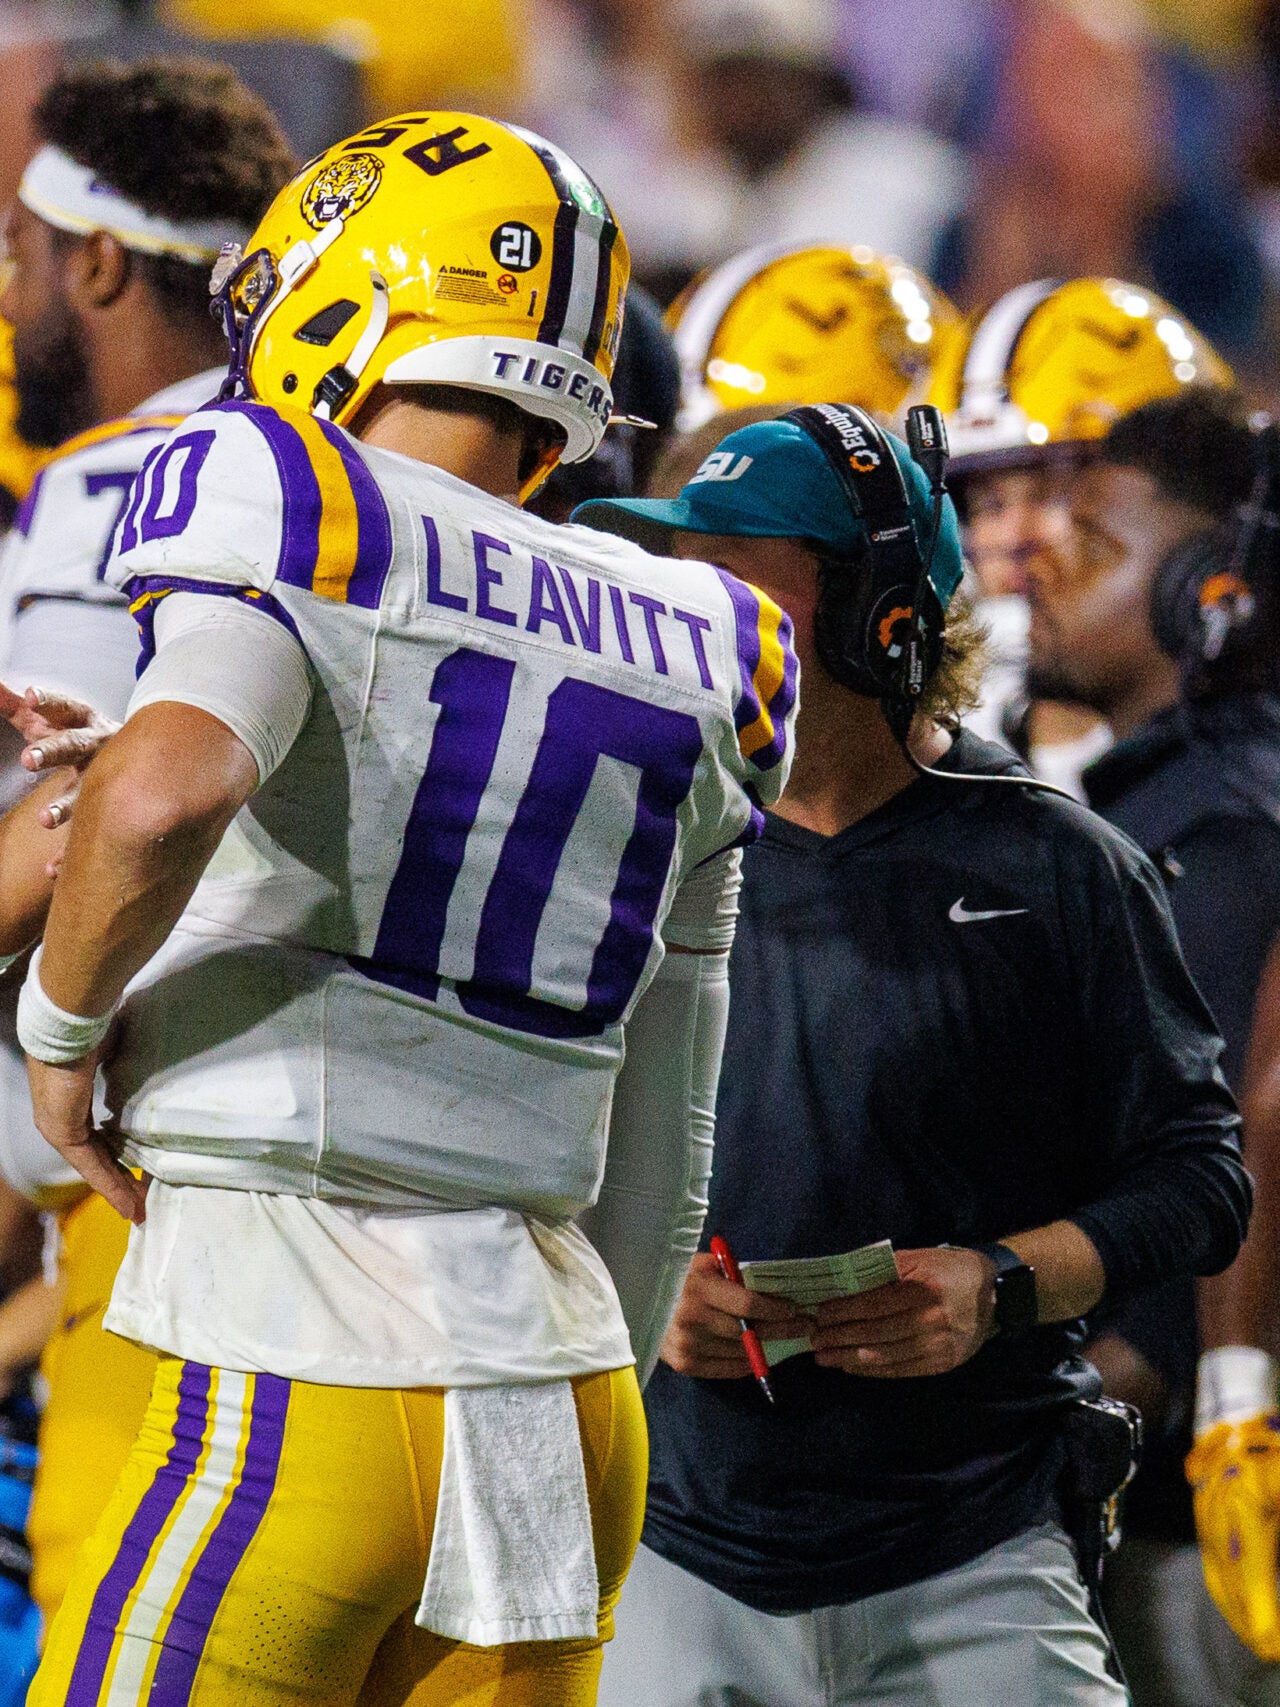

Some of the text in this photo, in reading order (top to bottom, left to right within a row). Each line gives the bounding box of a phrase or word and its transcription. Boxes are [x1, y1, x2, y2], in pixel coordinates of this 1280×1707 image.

[449, 266, 487, 279] DANGER
[499, 226, 532, 268] 21
[493, 352, 613, 426] TIGERS
[118, 429, 216, 556] 10
[421, 515, 714, 690] LEAVITT
[347, 647, 703, 1038] 10
